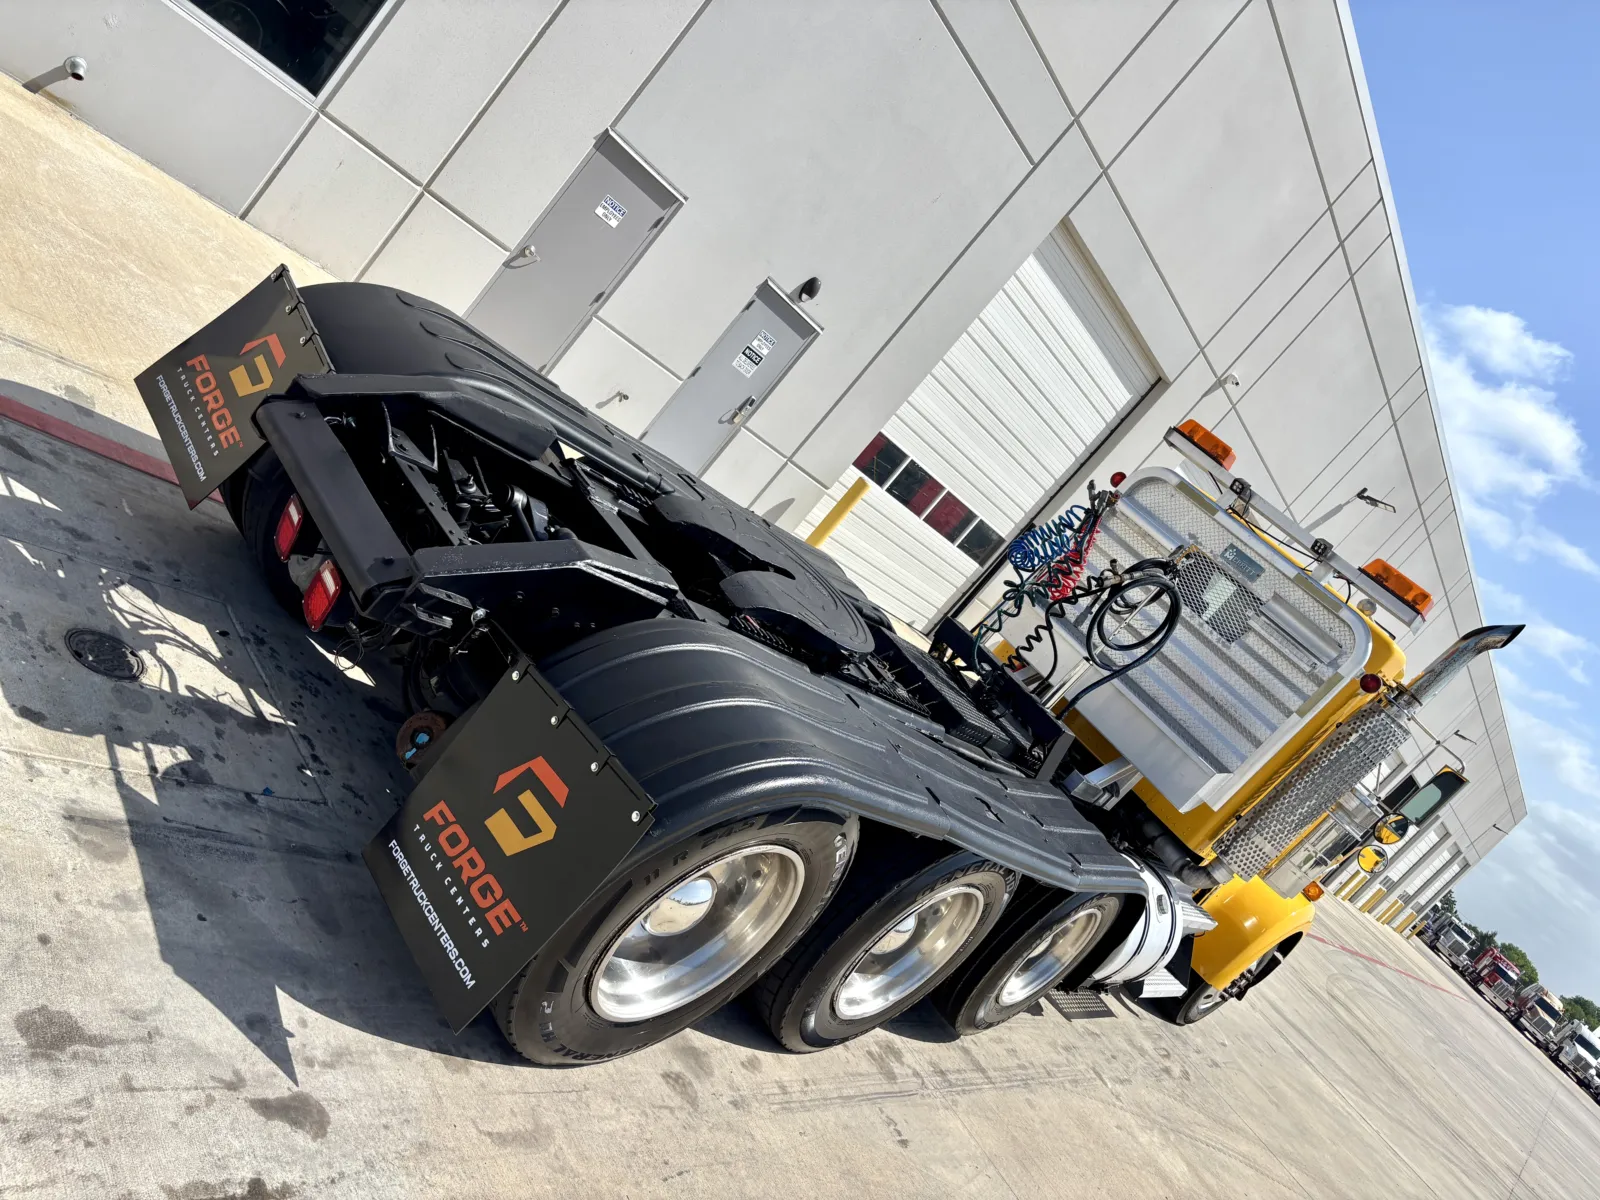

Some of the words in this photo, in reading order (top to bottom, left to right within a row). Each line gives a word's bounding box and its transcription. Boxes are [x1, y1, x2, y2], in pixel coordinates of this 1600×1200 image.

[600, 203, 621, 222] EMPLOYEES
[604, 196, 627, 217] NOTICE
[744, 348, 761, 364] NOTICE
[760, 331, 775, 346] NOTICE
[156, 374, 207, 482] FORGETRUCKCENTERS.COM
[177, 367, 195, 402] TRUCK
[194, 406, 219, 457] CENTERS
[186, 353, 241, 449] FORGE
[388, 839, 476, 990] FORGETRUCKCENTERS.COM
[412, 824, 443, 871] TRUCK
[444, 877, 490, 948] CENTERS
[423, 800, 522, 936] FORGE
